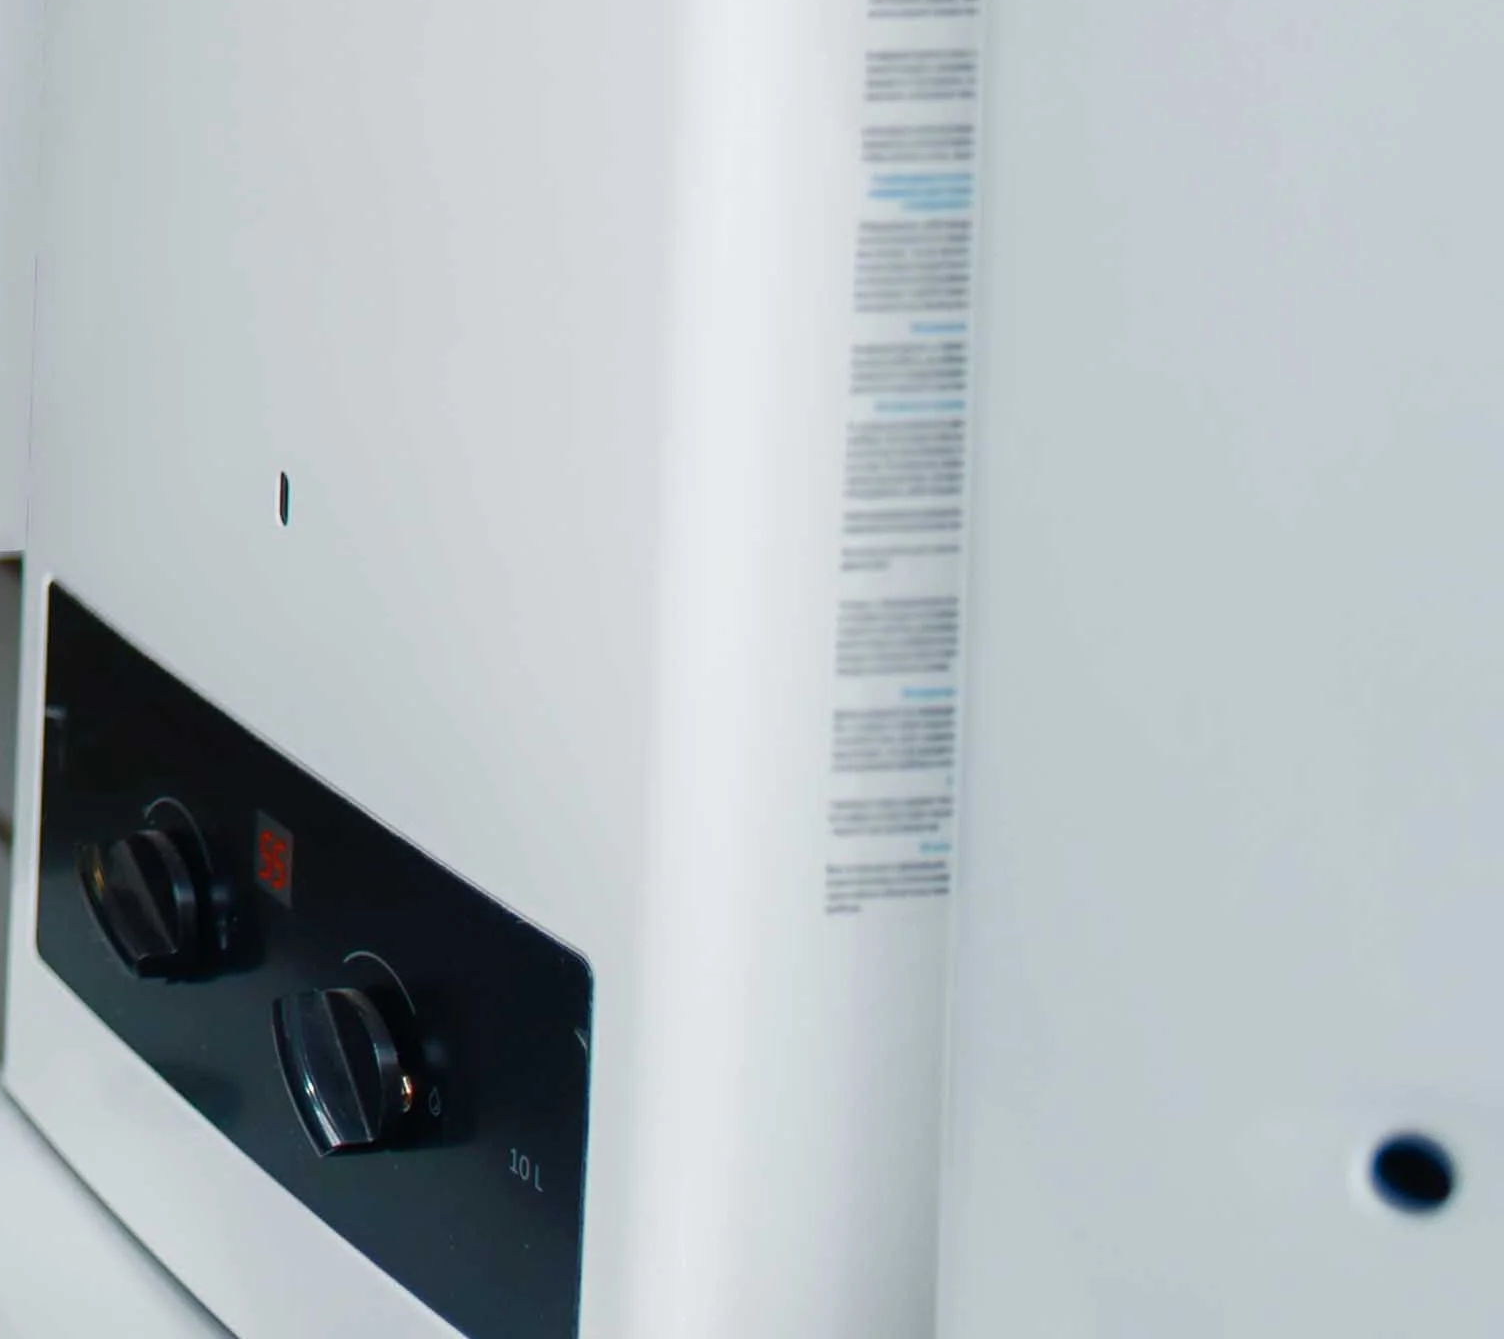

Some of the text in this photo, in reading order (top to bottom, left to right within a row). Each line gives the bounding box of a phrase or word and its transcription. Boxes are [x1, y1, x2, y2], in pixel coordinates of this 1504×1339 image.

[258, 829, 287, 891] 55
[509, 1147, 544, 1193] 10 L
